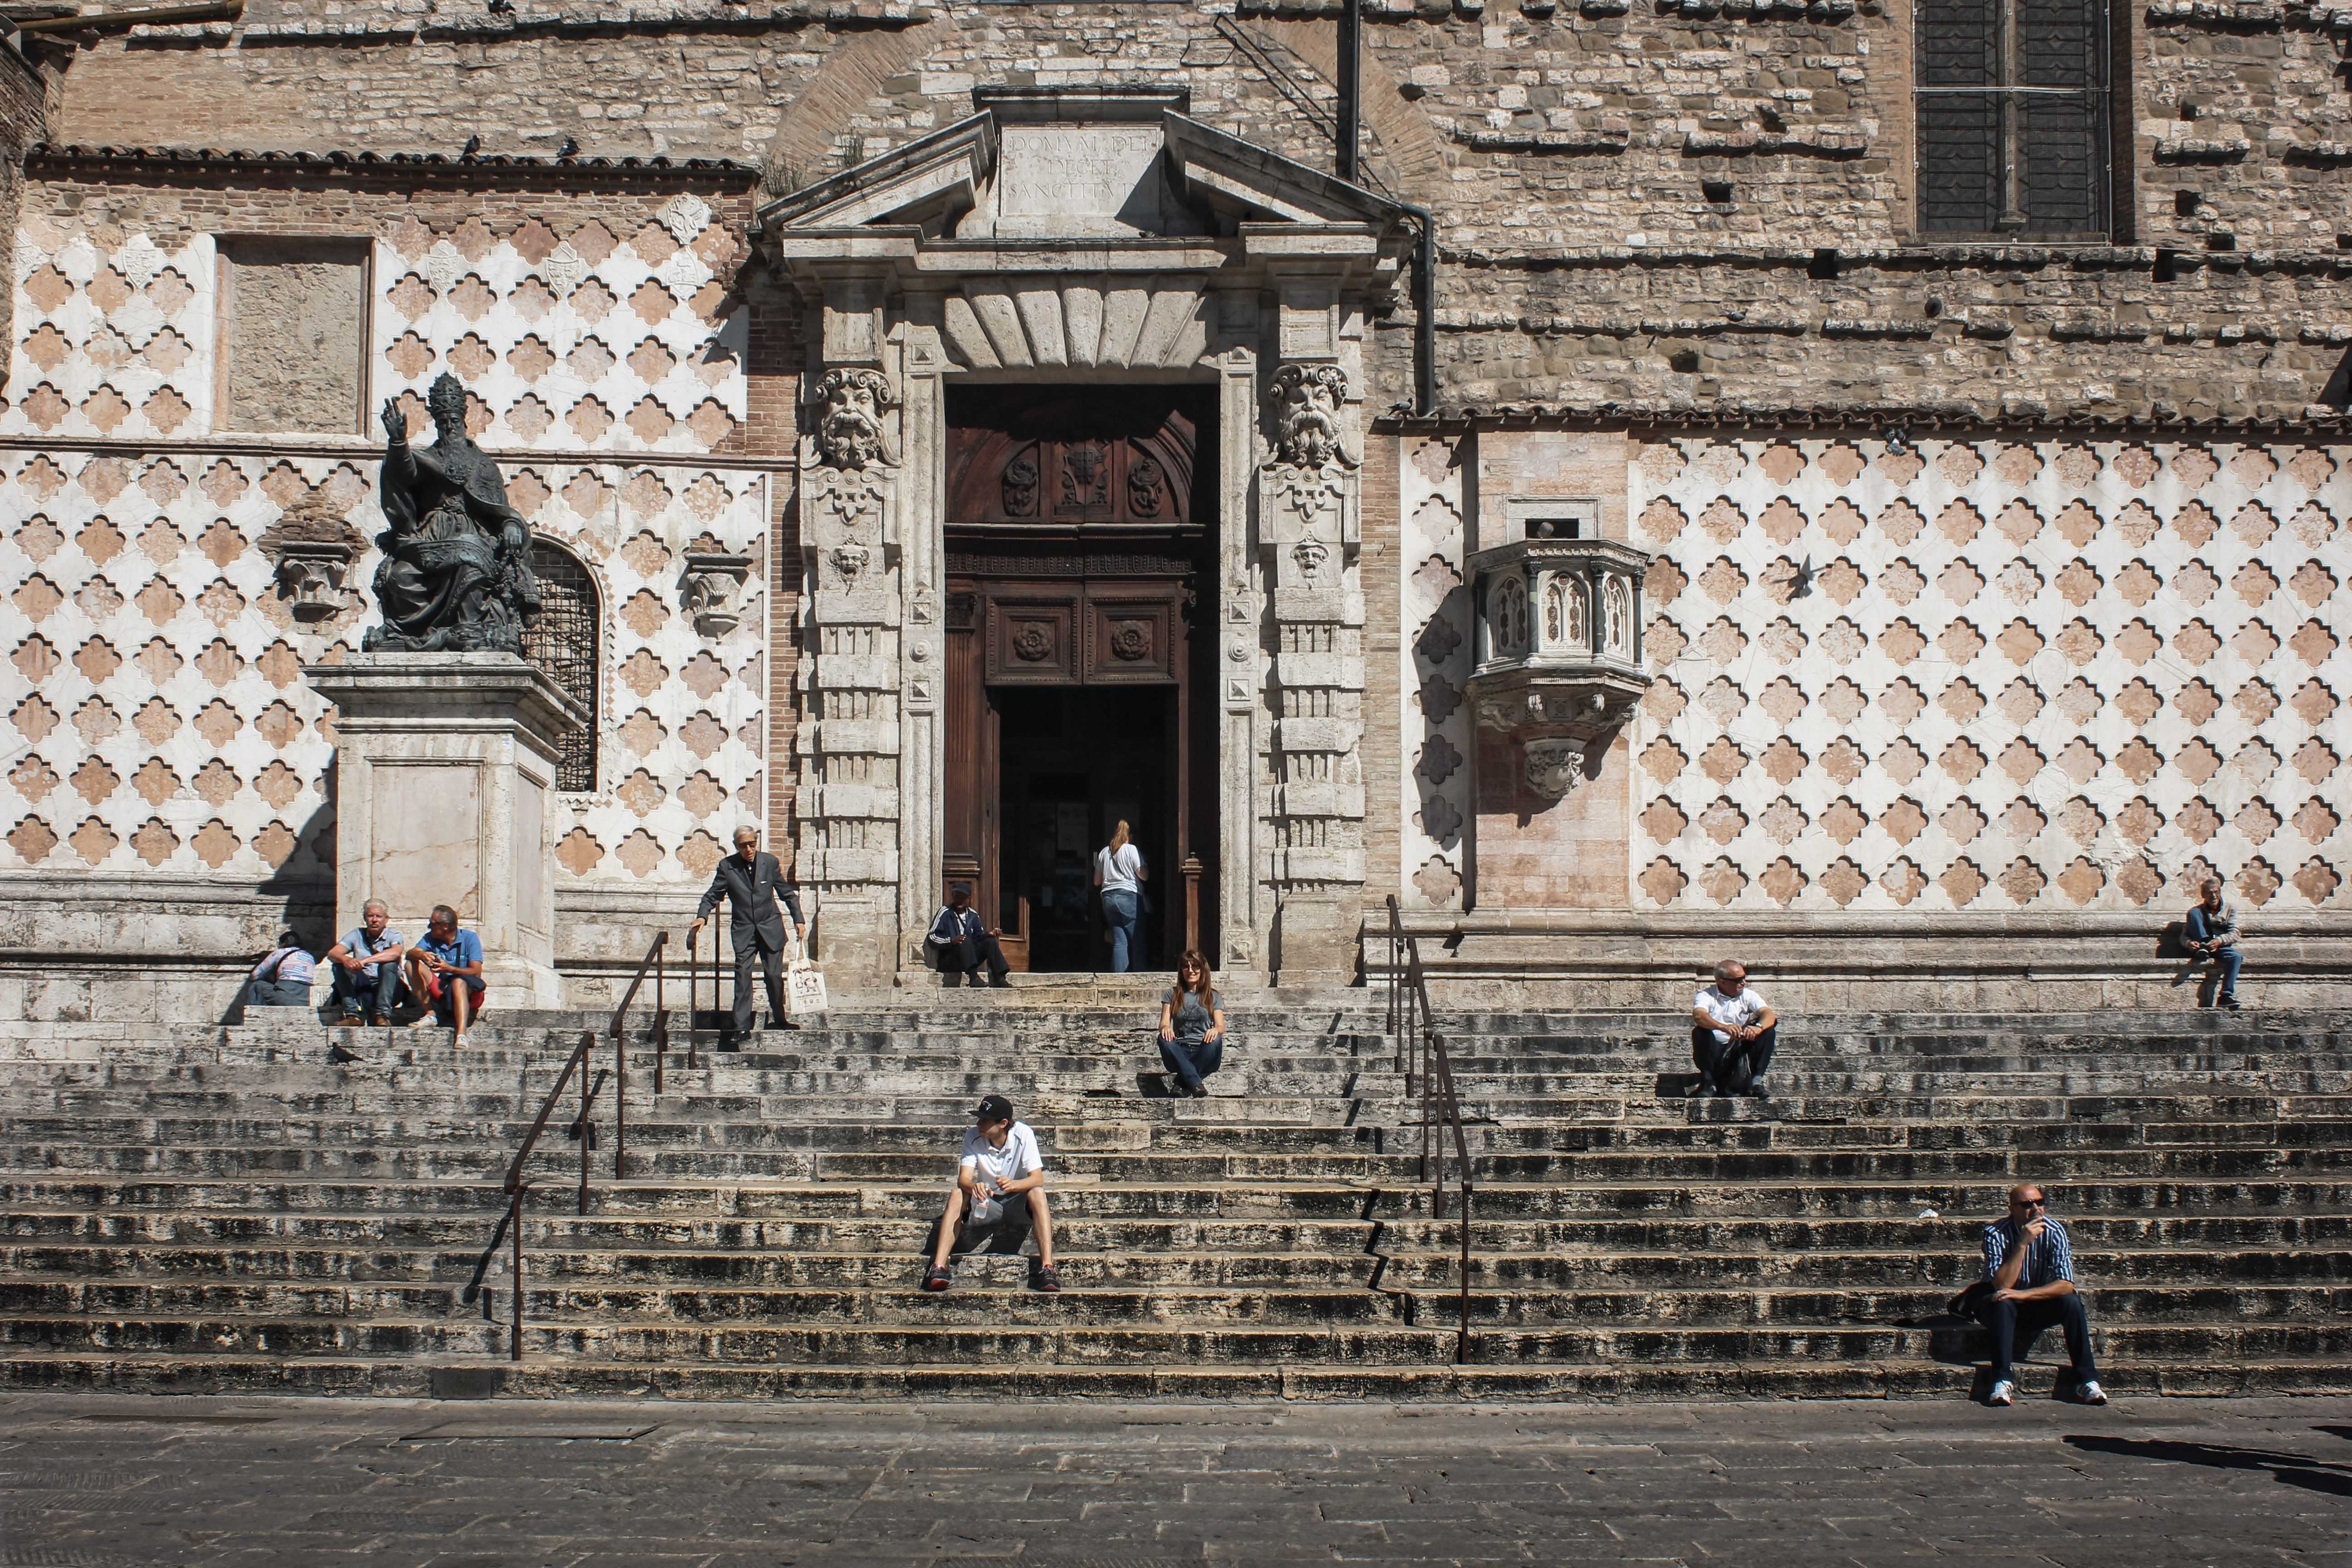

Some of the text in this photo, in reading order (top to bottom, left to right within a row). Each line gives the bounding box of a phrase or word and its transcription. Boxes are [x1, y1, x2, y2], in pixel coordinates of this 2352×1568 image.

[1112, 136, 1147, 151] DEI
[1049, 159, 1114, 175] DECET
[1008, 182, 1153, 199] SANCTITVD
